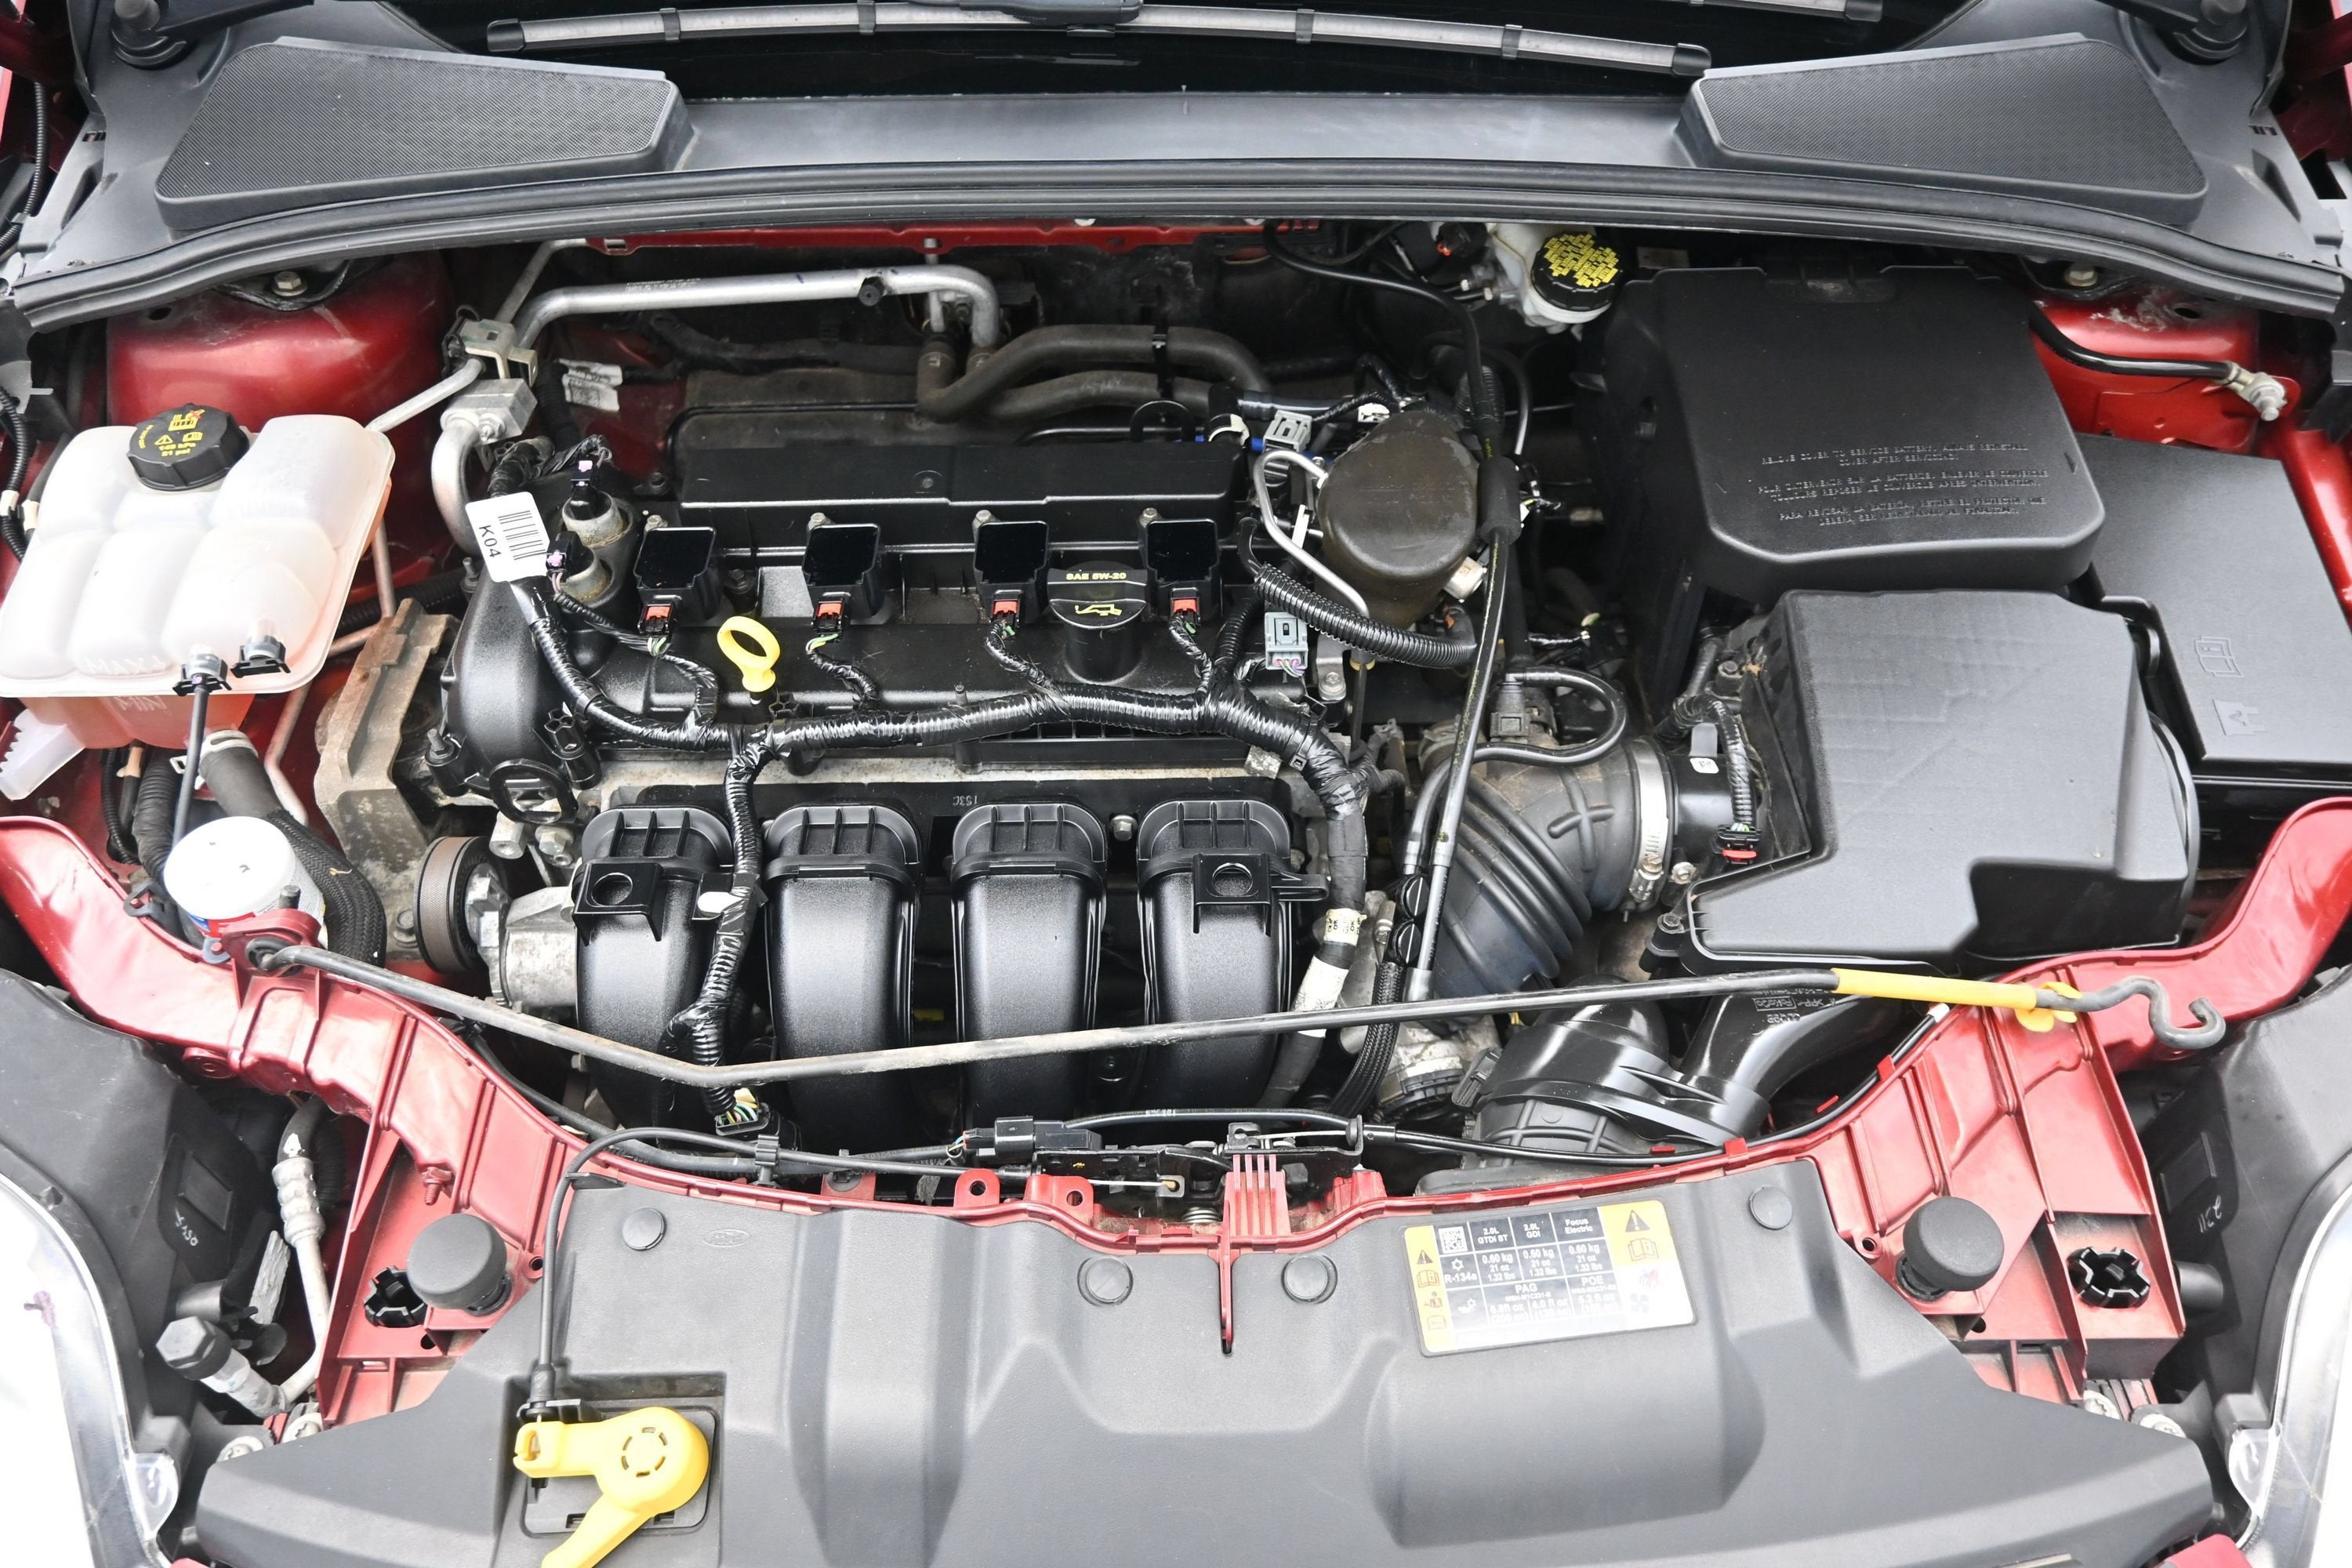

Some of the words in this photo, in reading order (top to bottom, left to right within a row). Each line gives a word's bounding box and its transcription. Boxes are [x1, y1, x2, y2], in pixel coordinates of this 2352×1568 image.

[1801, 451, 1829, 460] COVER
[1850, 447, 1889, 456] SERVICE
[1839, 458, 1867, 466] COVER
[1872, 456, 1900, 464] AFTER
[478, 524, 502, 557] K04
[1092, 572, 1127, 580] 5W-20
[1523, 1223, 1540, 1232] 2.0L
[1565, 1218, 1588, 1228] Focus
[1483, 1227, 1500, 1236] 2.0L
[1526, 1230, 1541, 1239] GDI
[1564, 1225, 1593, 1234] Electric
[1478, 1234, 1497, 1244] GTDI
[1523, 1249, 1542, 1259] 0.60
[1543, 1248, 1555, 1259] kg
[1567, 1244, 1588, 1255] 0.60
[1588, 1243, 1600, 1254] kg
[1482, 1254, 1501, 1264] 0.60
[1501, 1253, 1513, 1264] kg
[1577, 1254, 1586, 1263] 21
[1575, 1263, 1591, 1272] 1.32
[1592, 1261, 1603, 1271] lbs
[1444, 1272, 1477, 1283] R-134a
[1488, 1273, 1503, 1282] 1.32
[1504, 1272, 1515, 1281] lbs
[1529, 1269, 1544, 1277] 1.32
[1546, 1268, 1558, 1276] lbs
[1581, 1275, 1604, 1286] POE
[1515, 1283, 1537, 1294] PAG
[1532, 1300, 1548, 1310] 4.0
